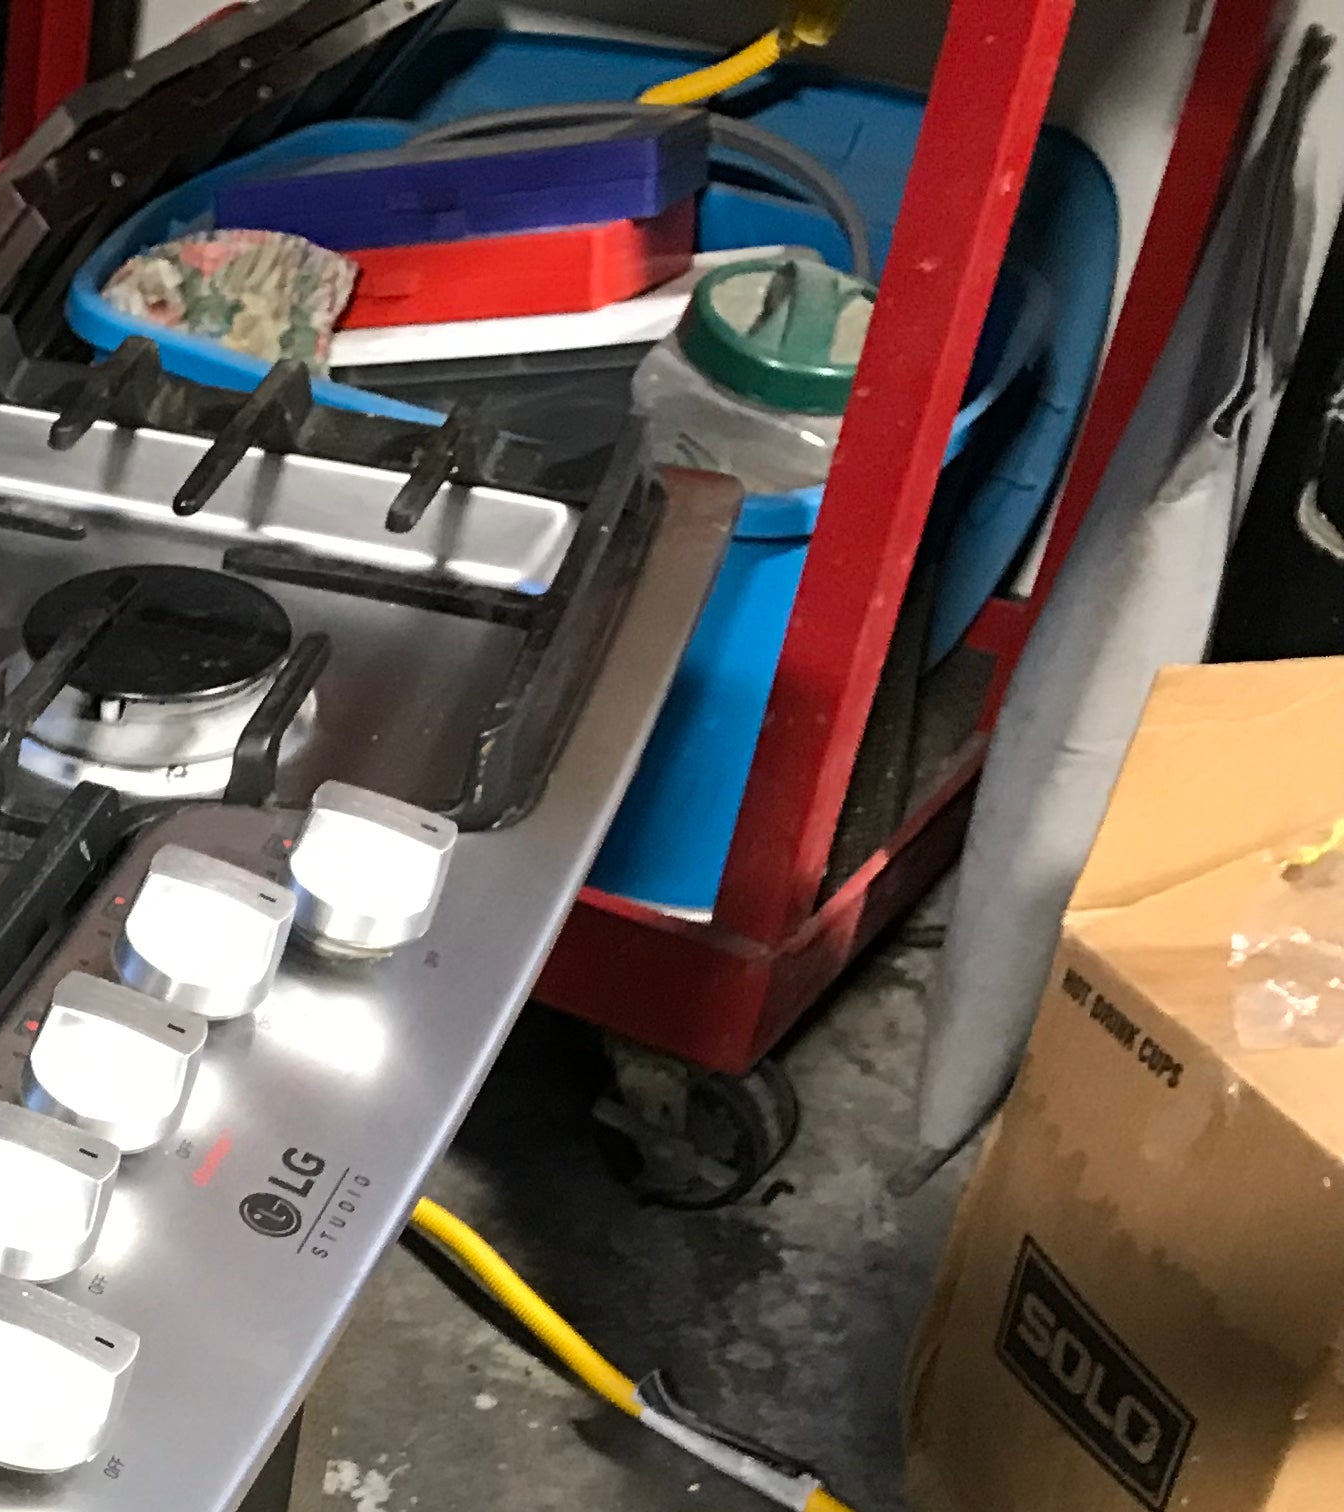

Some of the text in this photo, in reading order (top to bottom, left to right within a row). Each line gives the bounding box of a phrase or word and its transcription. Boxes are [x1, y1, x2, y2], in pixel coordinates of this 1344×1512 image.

[1062, 968, 1184, 1088] HOT DRINK CUPS
[268, 1147, 325, 1198] LG
[311, 1174, 371, 1259] STUDIO
[88, 1273, 108, 1295] OFF
[1016, 1293, 1161, 1464] SOLO
[103, 1456, 125, 1479] OFF
